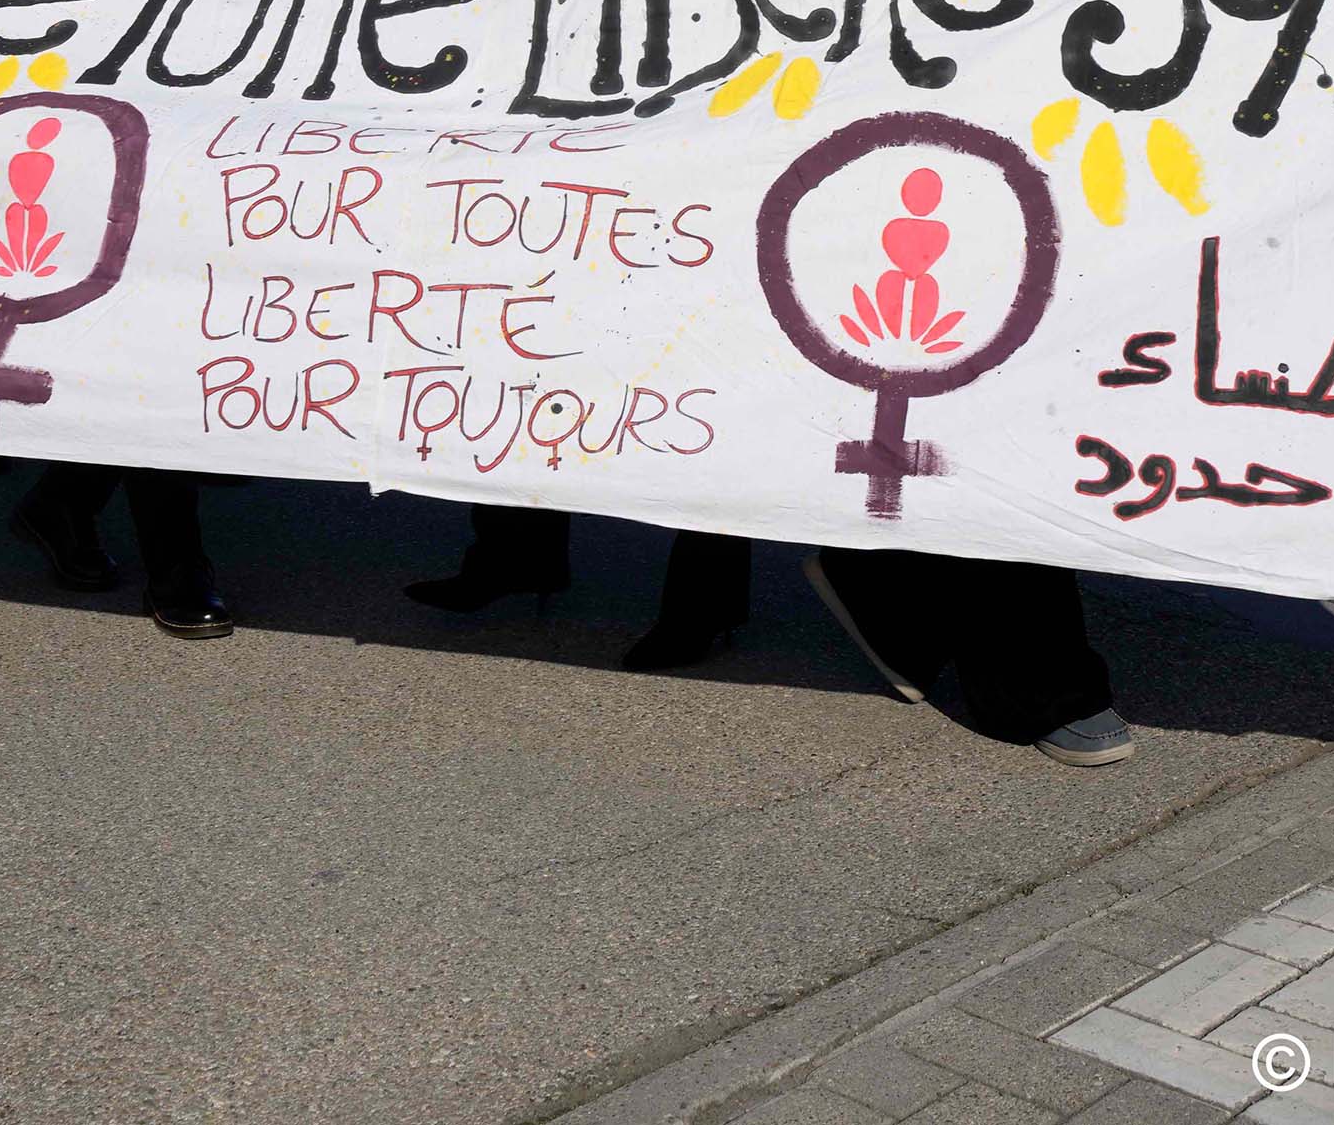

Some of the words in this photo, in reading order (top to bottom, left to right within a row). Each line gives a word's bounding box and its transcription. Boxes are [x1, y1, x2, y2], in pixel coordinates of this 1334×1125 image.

[221, 164, 379, 249] POUR
[426, 178, 714, 268] TOUTES
[201, 262, 584, 359] LIBERTÉ
[196, 355, 358, 440] POUR
[383, 365, 717, 472] TOUJOURS
